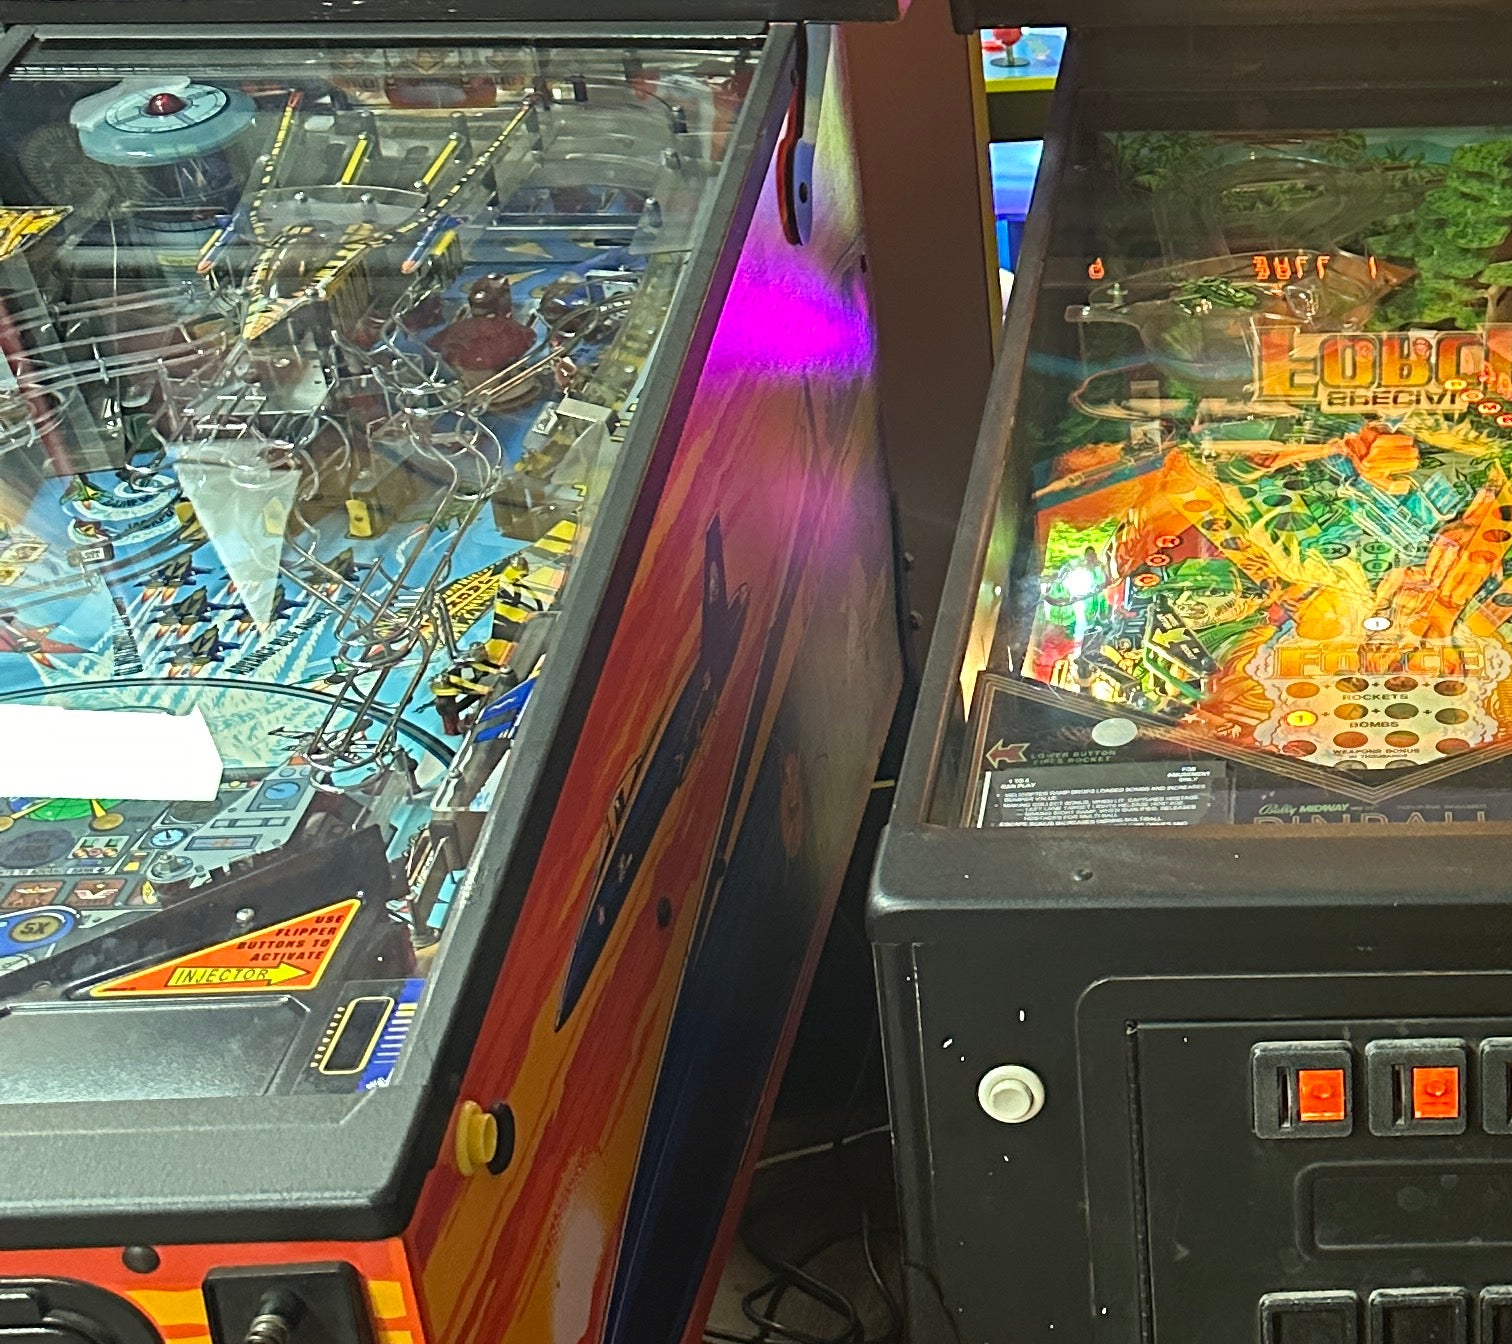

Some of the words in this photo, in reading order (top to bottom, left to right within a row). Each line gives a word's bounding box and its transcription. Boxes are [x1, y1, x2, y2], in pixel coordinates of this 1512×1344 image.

[1342, 693, 1409, 701] ROCKETS
[1349, 721, 1400, 729] BOMBS
[1073, 750, 1117, 758] BUTTON
[1299, 803, 1350, 813] MIDWAY
[315, 914, 345, 925] USE
[20, 921, 50, 936] 5X
[275, 926, 337, 937] FLIPPER
[237, 940, 305, 950] BUTTONS
[312, 939, 330, 948] TO
[250, 951, 325, 962] ACTIVATE
[174, 968, 269, 985] INJECTOR
